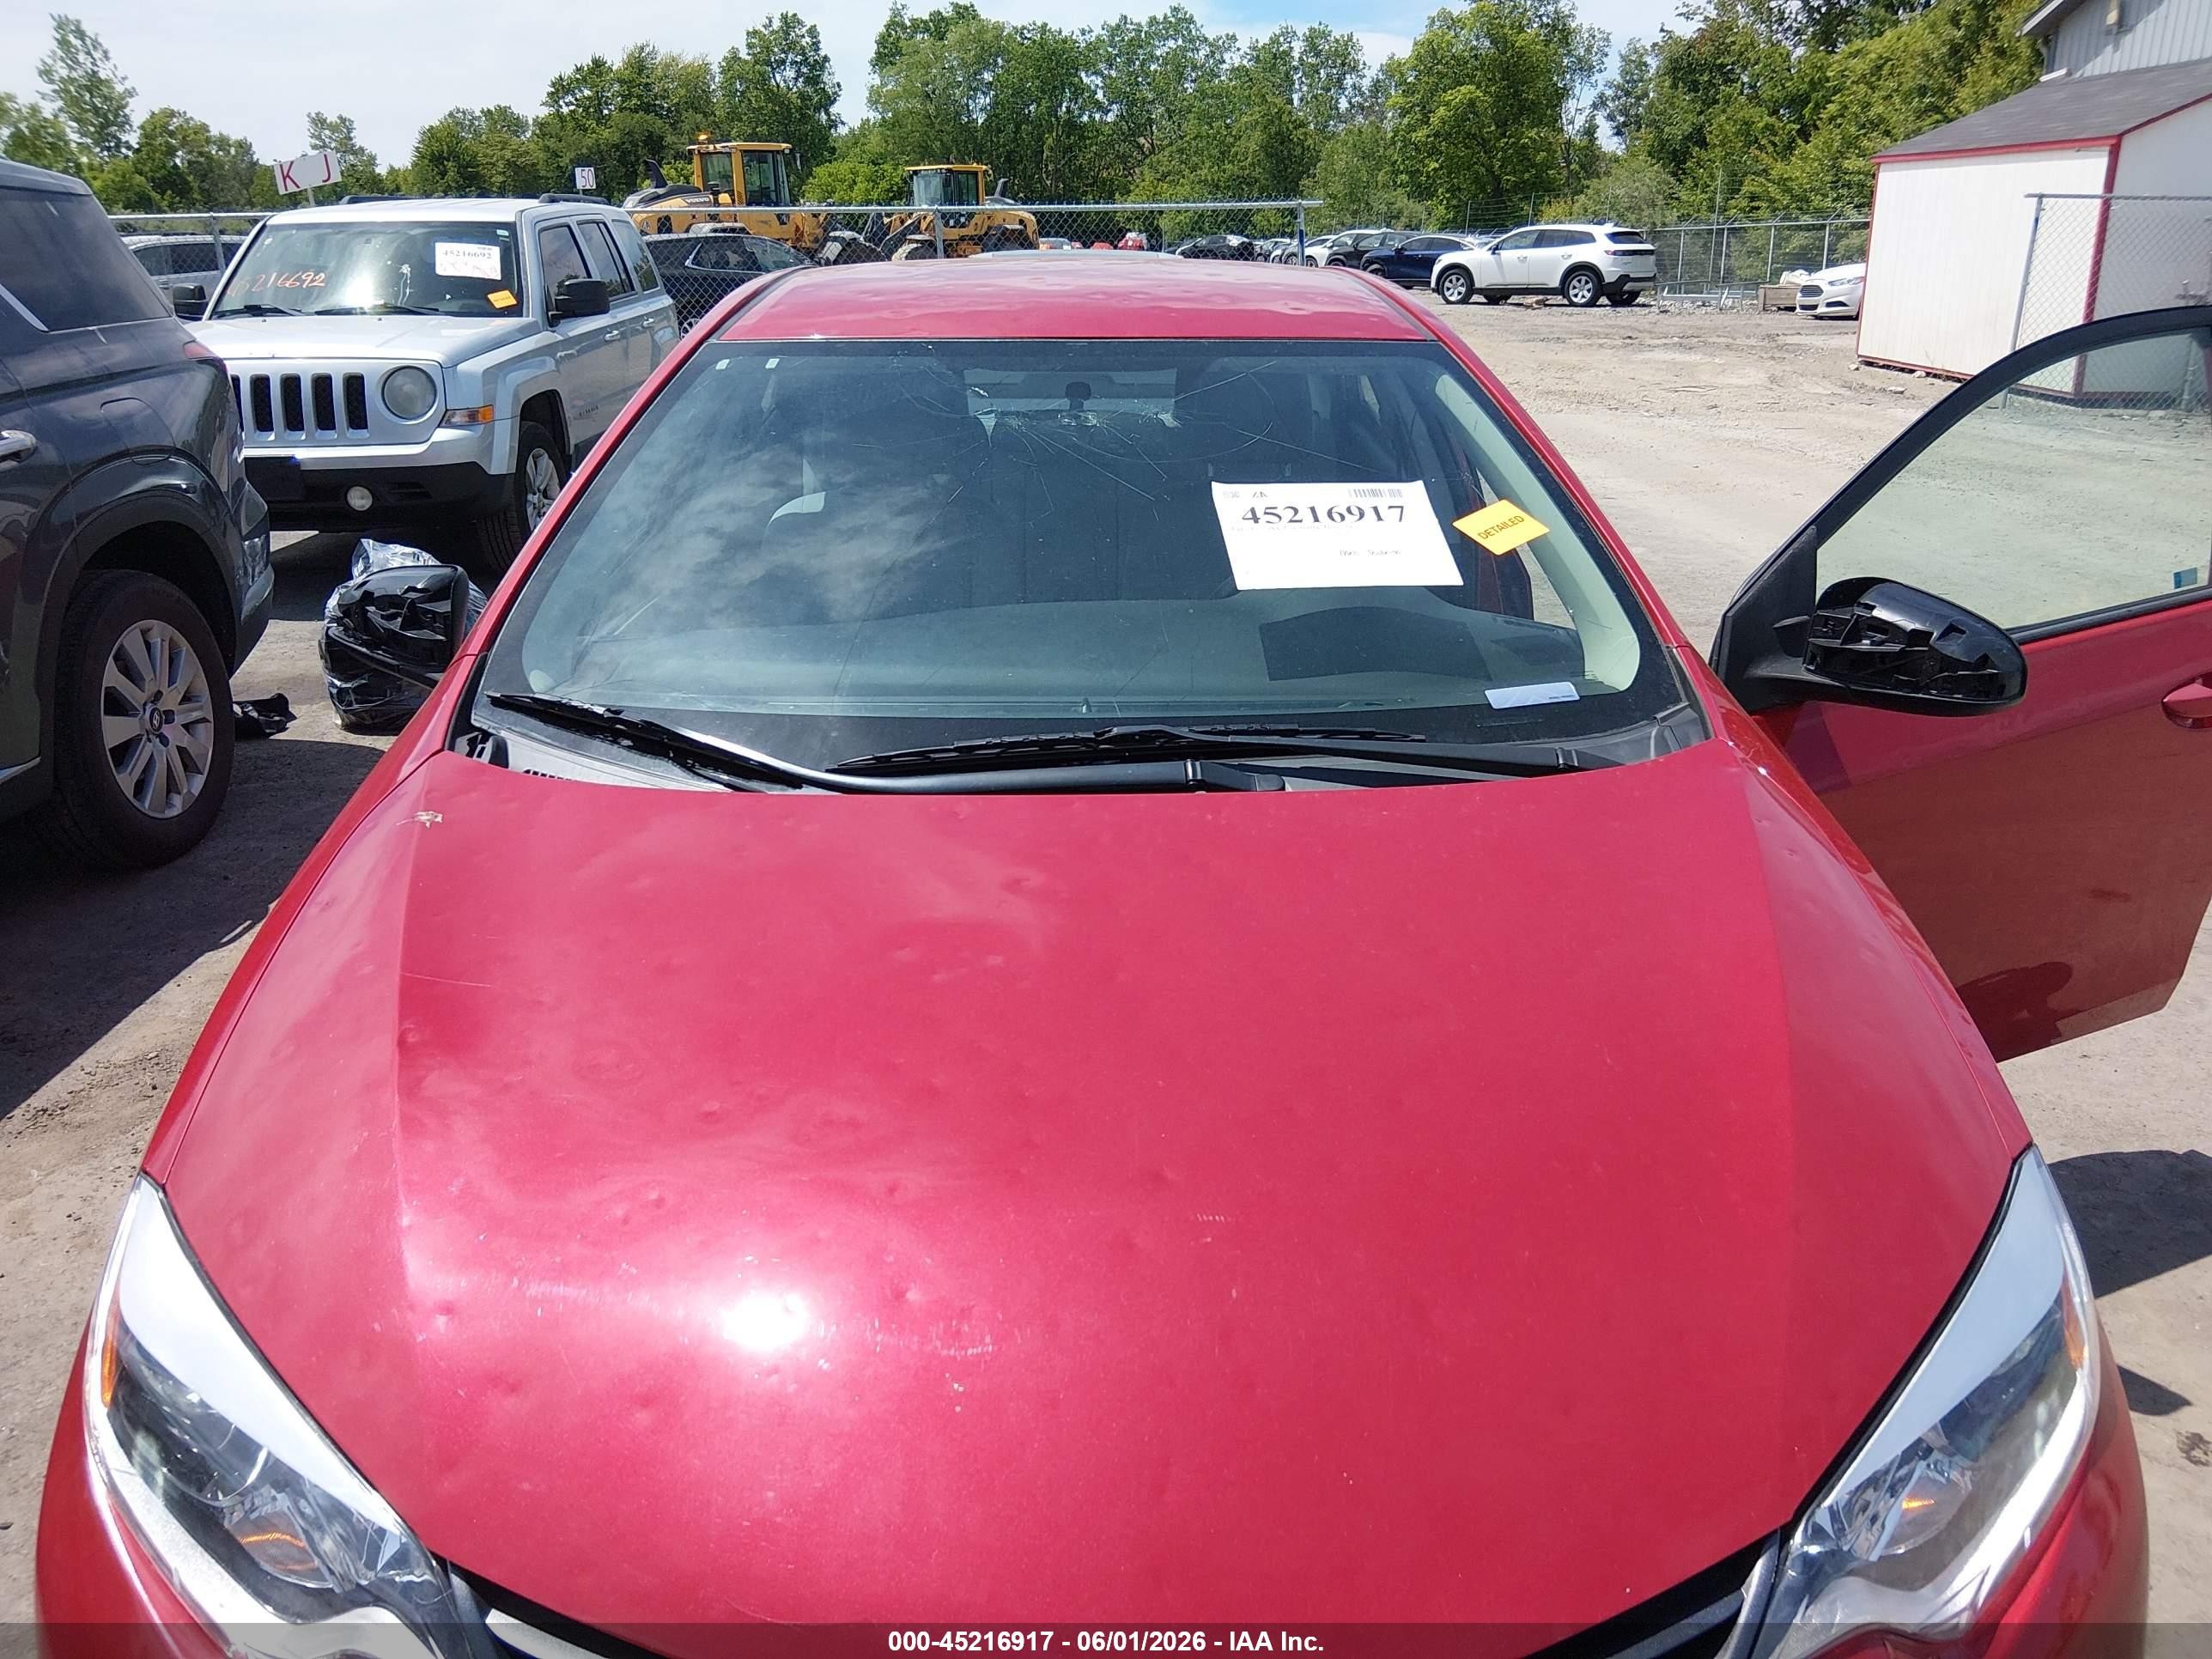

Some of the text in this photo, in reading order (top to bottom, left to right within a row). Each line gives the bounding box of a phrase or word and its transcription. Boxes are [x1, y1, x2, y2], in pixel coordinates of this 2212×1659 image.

[279, 154, 331, 191] K J
[580, 168, 594, 187] 50
[442, 249, 492, 259] 45216692
[1242, 505, 1405, 525] 45216917
[1477, 515, 1525, 540] DETAILED
